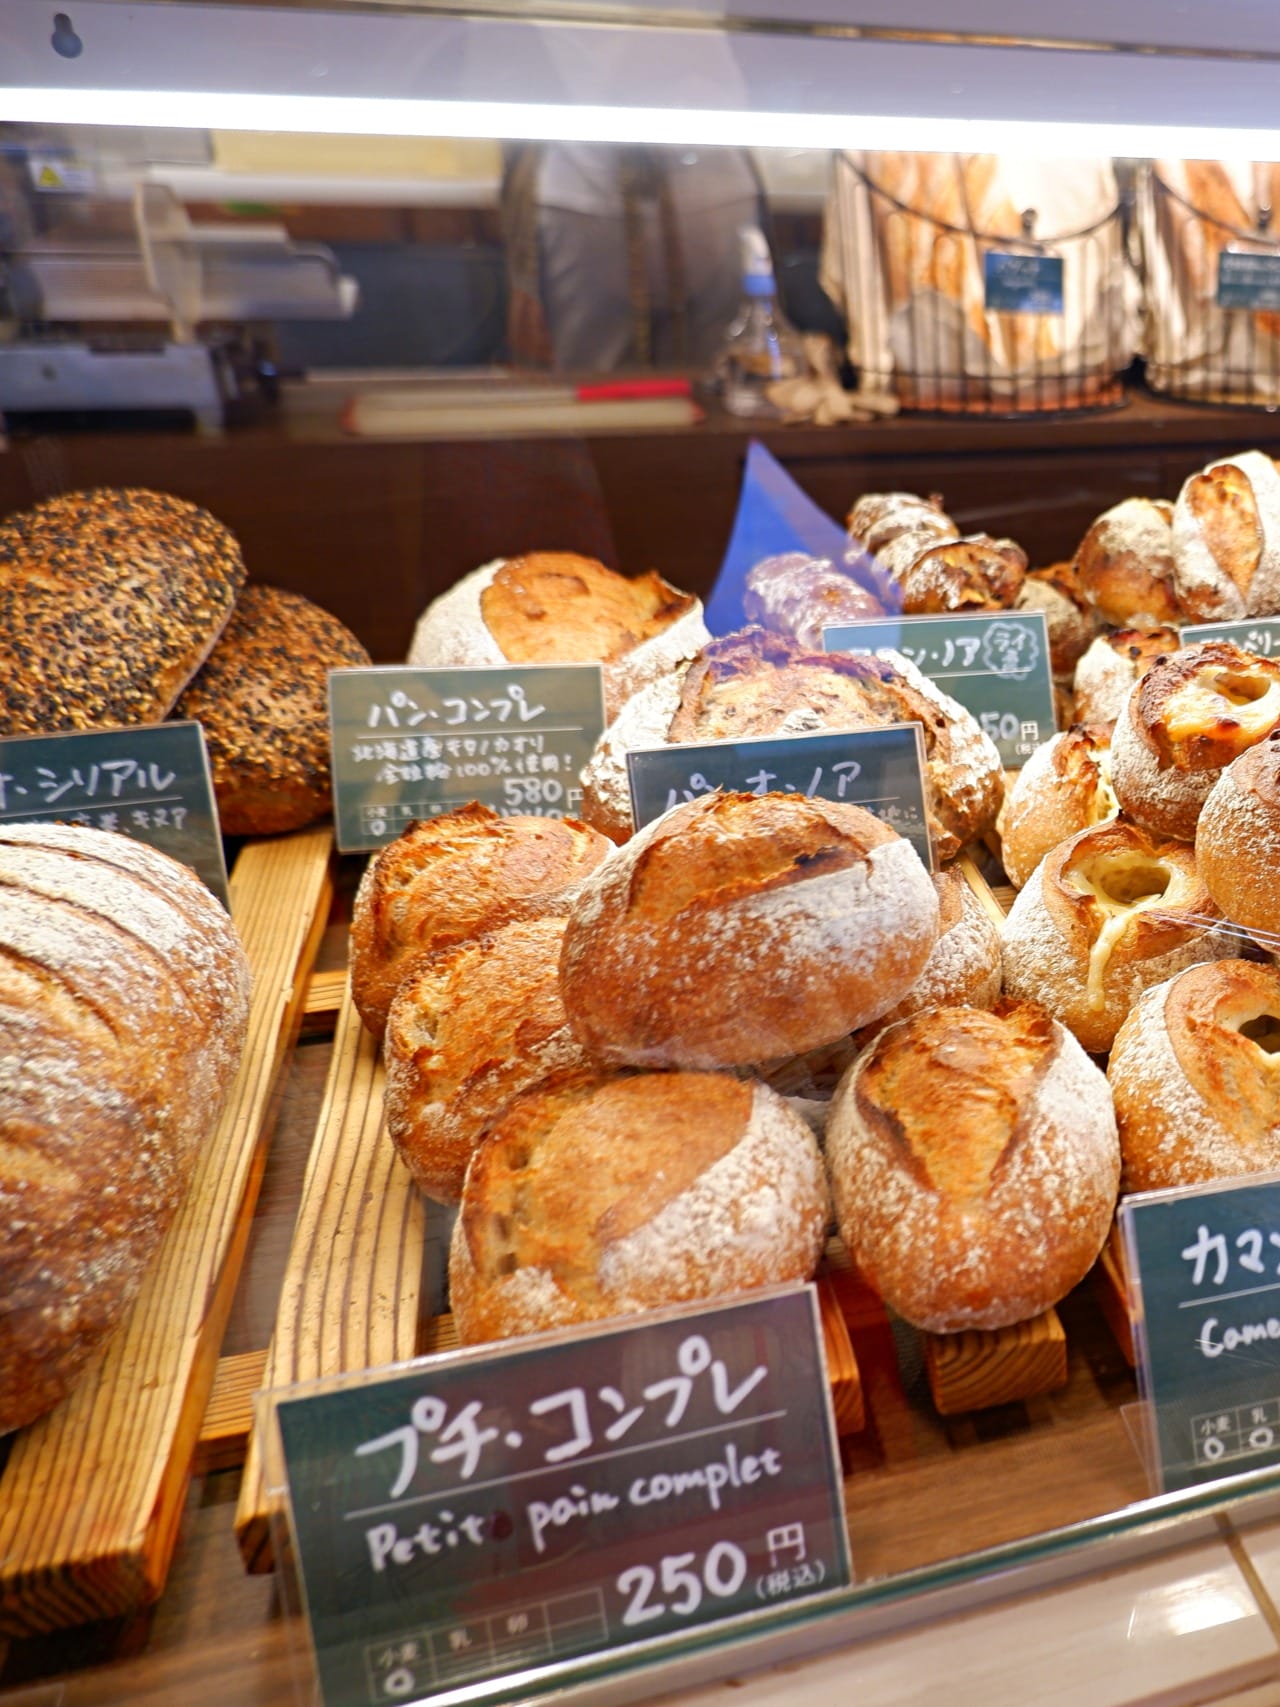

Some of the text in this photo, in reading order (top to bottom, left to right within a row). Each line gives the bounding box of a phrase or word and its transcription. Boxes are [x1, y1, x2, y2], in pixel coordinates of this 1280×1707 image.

[1020, 720, 1039, 742] 円
[503, 776, 565, 807] 580
[354, 1334, 768, 1500] プチ・コンプレ
[366, 1442, 782, 1573] Petit pain complet
[616, 1521, 806, 1627] 250 円
[755, 1559, 826, 1600] (税込)
